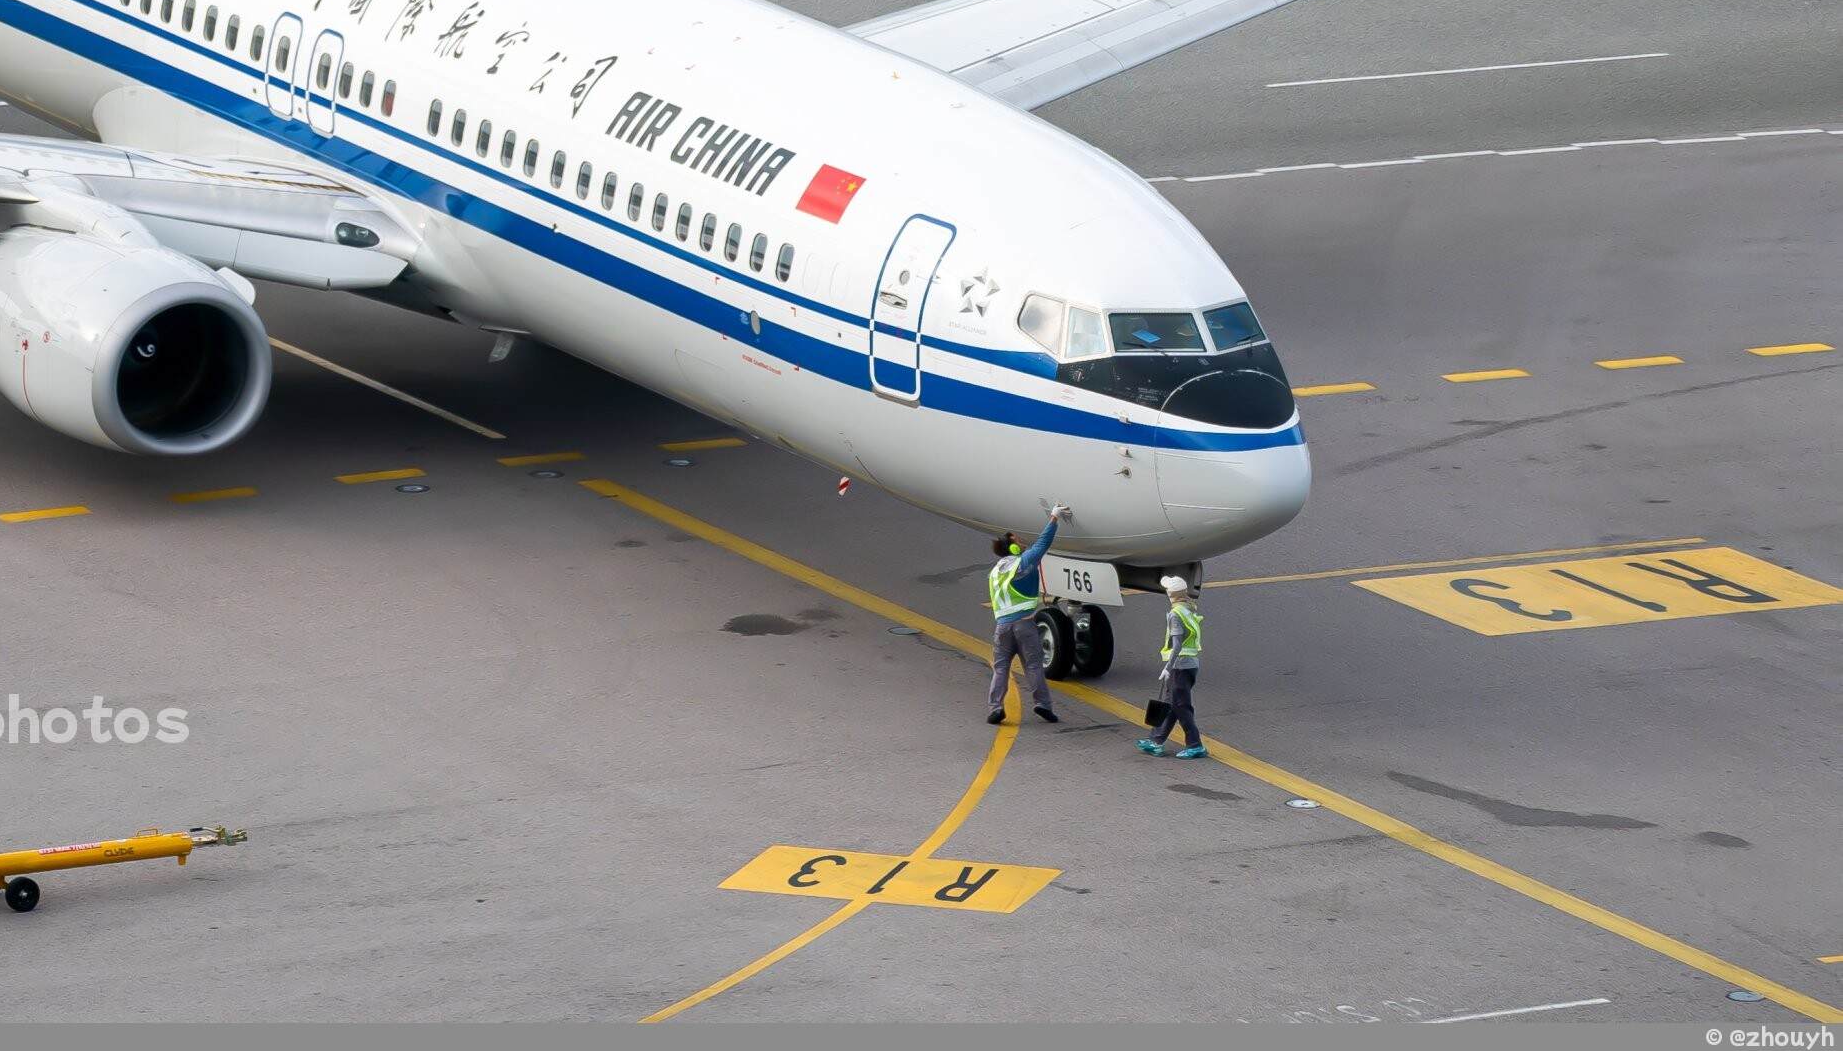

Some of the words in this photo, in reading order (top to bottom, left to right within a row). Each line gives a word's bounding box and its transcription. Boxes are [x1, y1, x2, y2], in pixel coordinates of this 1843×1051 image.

[606, 90, 683, 152] AIR
[669, 115, 797, 197] CHINA
[1062, 568, 1093, 594] 766
[1449, 558, 1782, 622] R13
[787, 854, 1001, 903] R13
